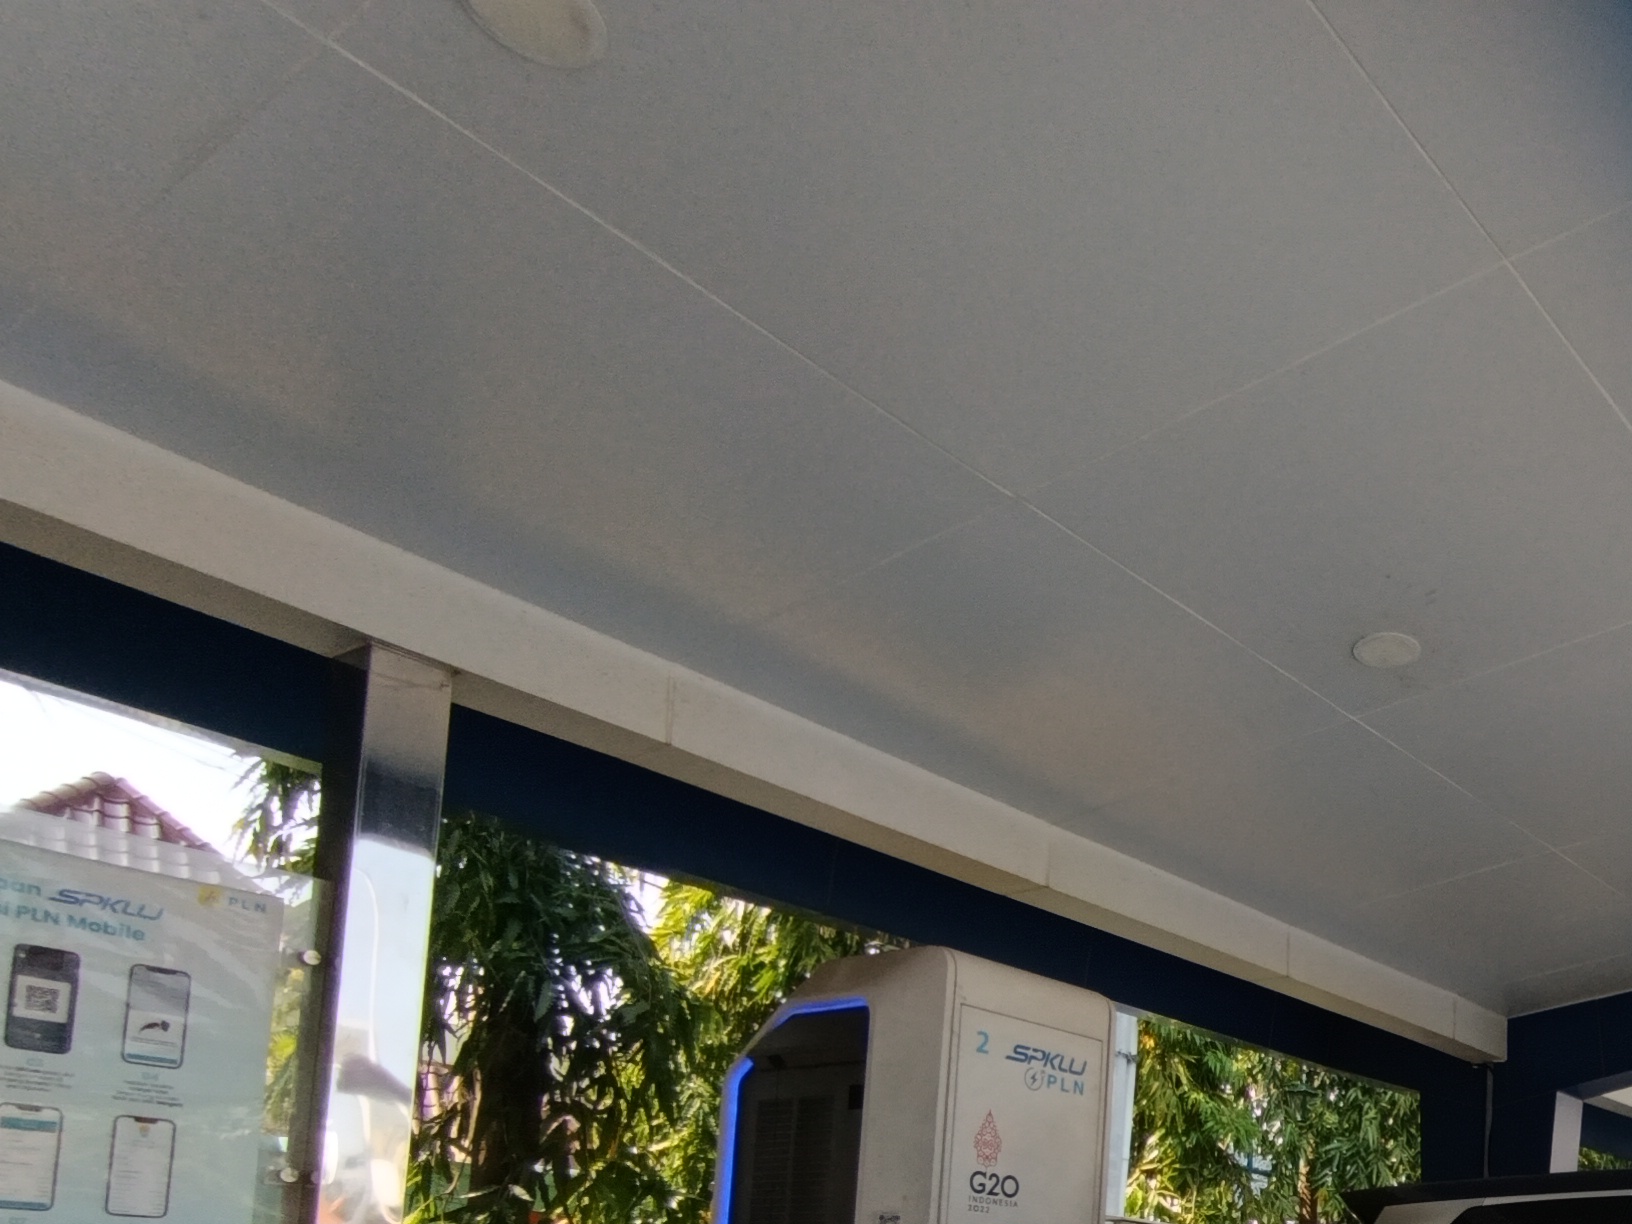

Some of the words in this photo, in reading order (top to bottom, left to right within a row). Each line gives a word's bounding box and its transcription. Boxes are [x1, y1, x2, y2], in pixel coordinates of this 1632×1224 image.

[48, 888, 163, 921] SPKLU
[228, 897, 267, 914] PLN
[17, 905, 60, 925] PLN
[67, 914, 146, 941] Mobile
[976, 1030, 989, 1054] 2
[1005, 1044, 1087, 1076] SPKLU
[1047, 1074, 1085, 1096] PLN
[969, 1170, 1019, 1198] G20
[968, 1195, 1018, 1207] INDONESIA
[968, 1204, 990, 1213] 2022
